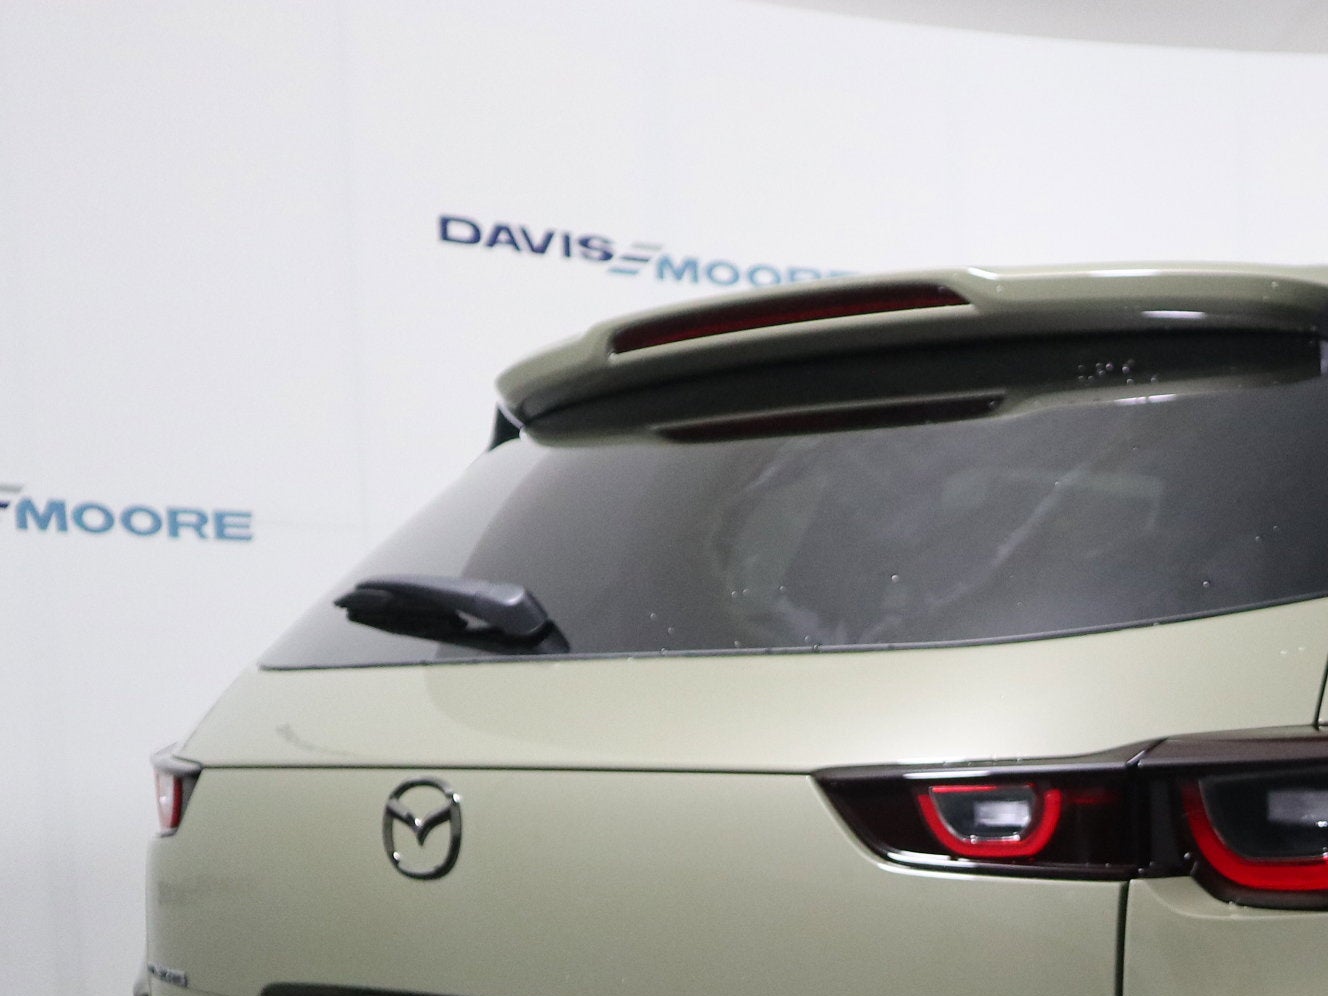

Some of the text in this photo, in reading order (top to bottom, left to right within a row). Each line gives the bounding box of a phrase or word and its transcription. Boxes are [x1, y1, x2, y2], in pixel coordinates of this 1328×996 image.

[438, 214, 862, 287] DAVIS MOO
[15, 496, 253, 541] MOORE
